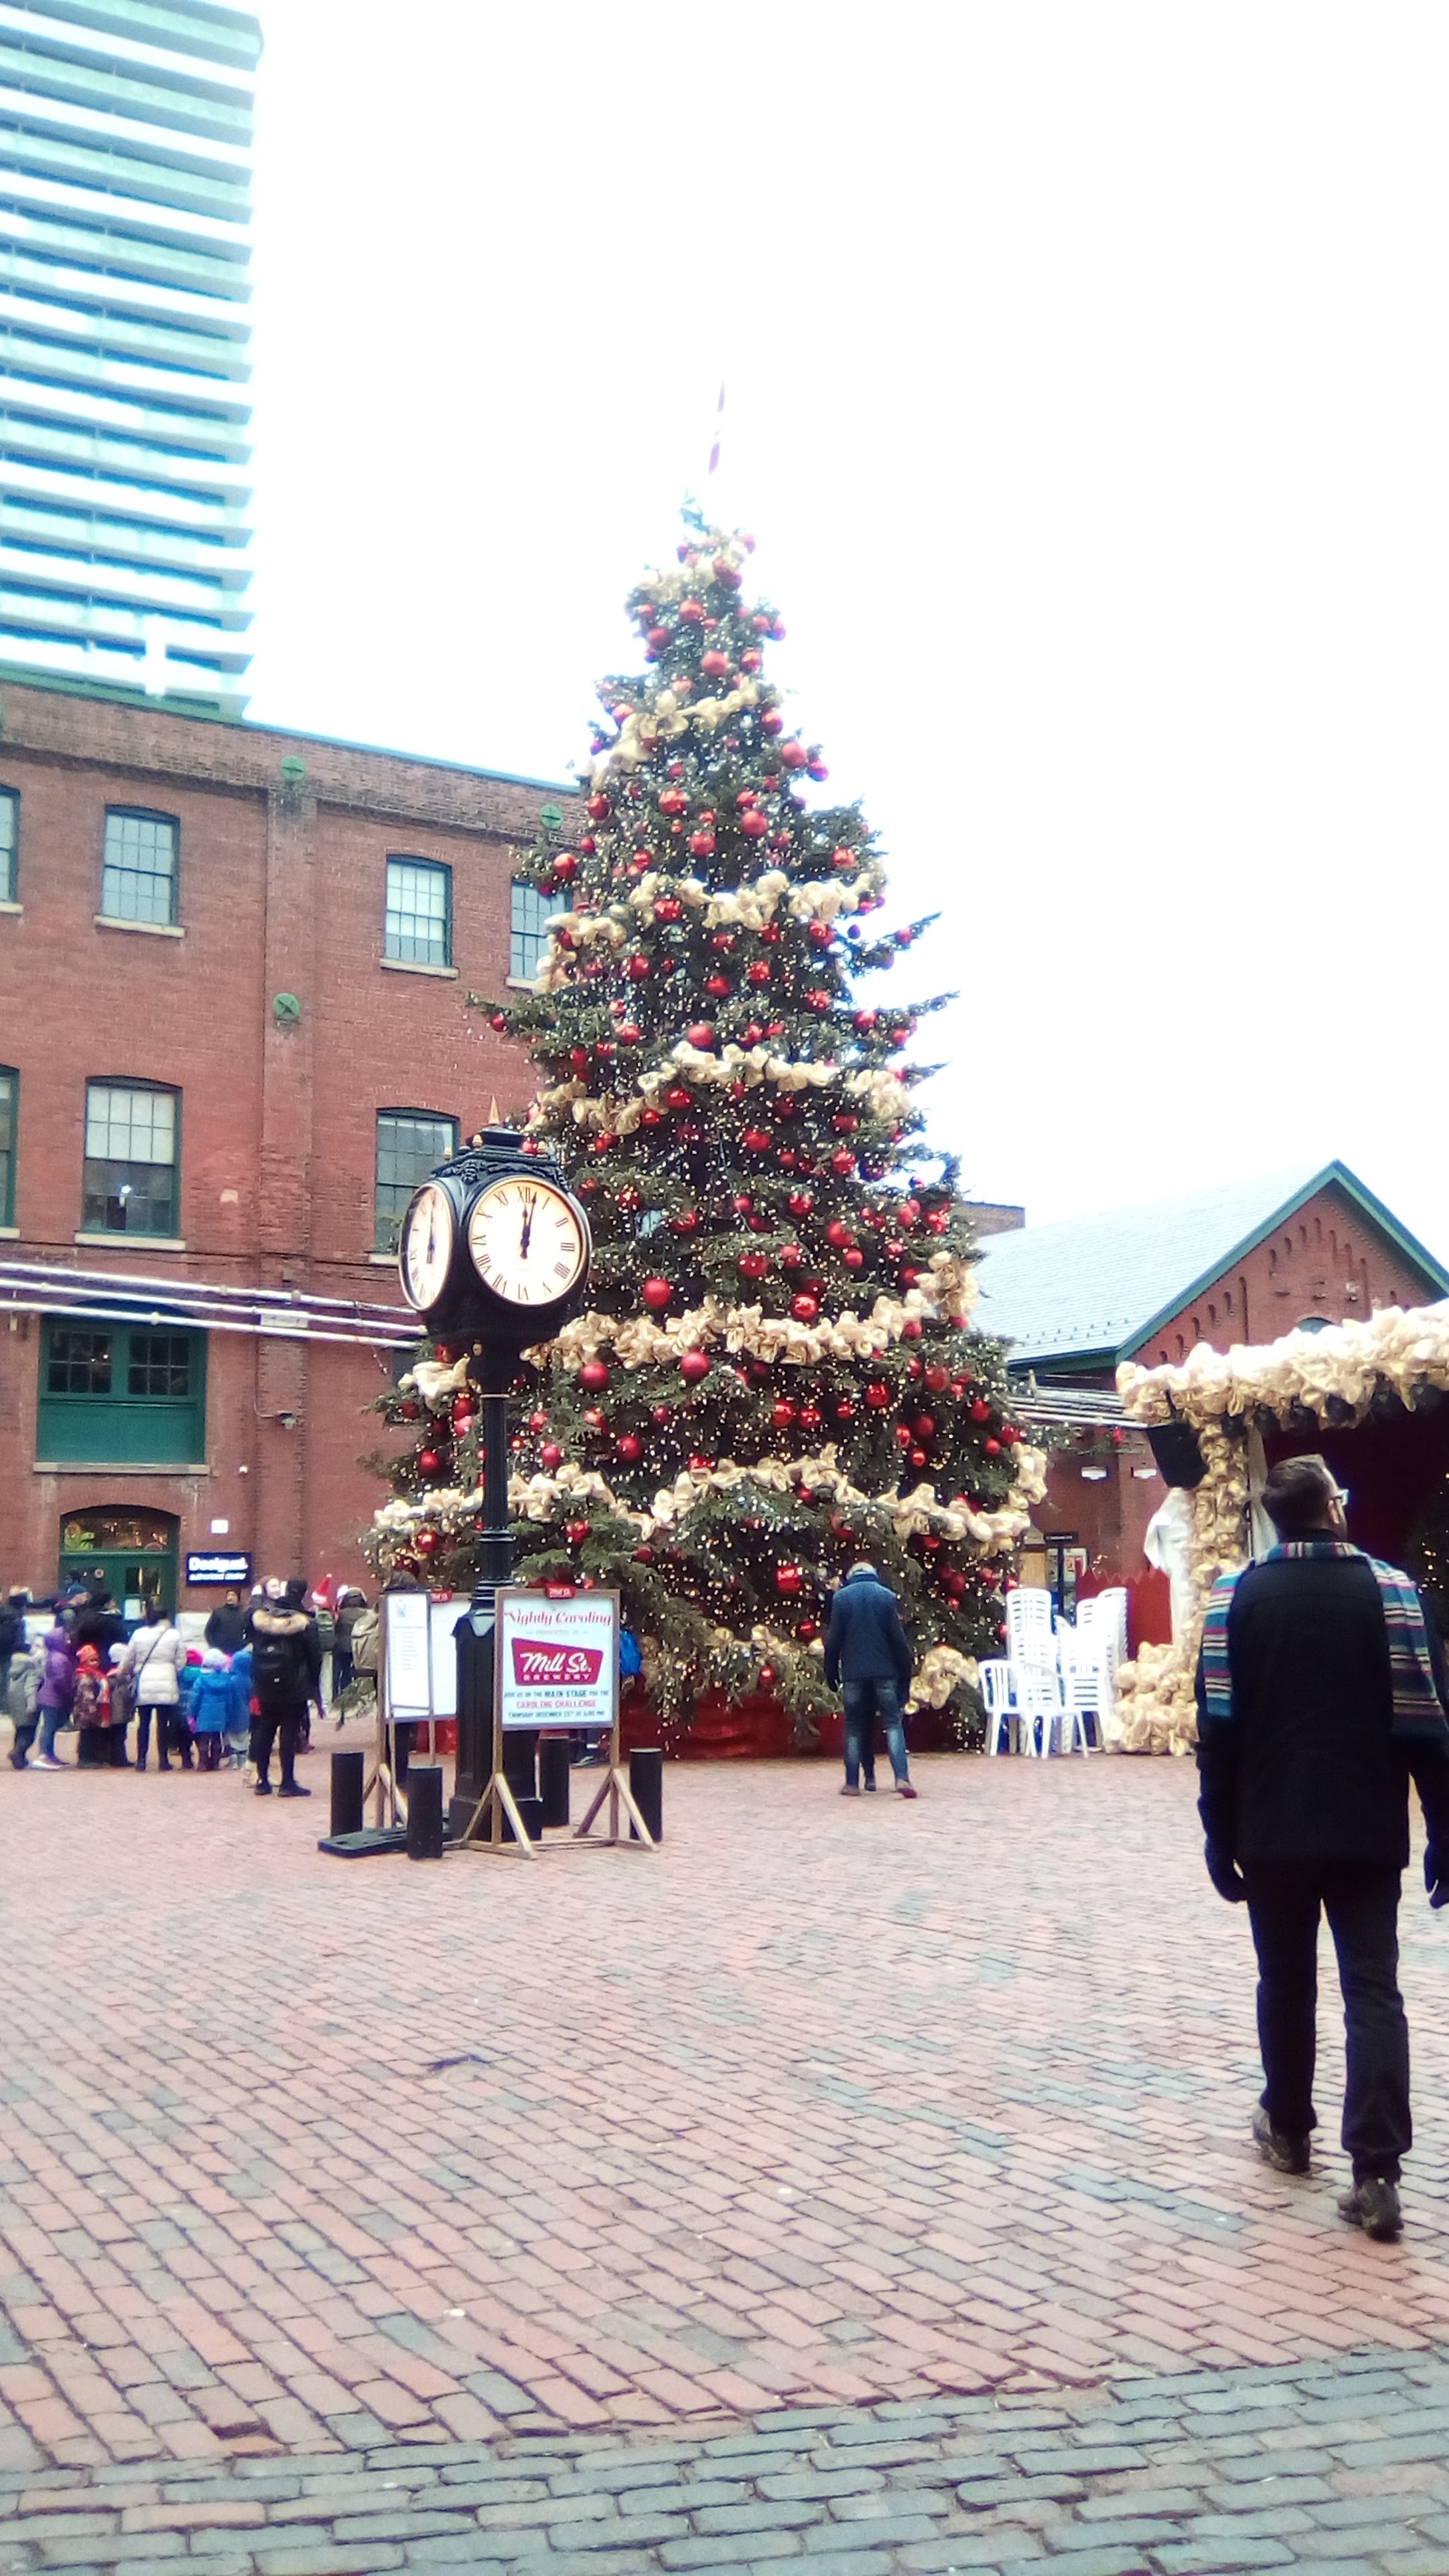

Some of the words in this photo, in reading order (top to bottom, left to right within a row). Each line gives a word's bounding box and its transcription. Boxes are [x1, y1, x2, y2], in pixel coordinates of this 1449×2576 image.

[517, 1186, 531, 1203] XII
[504, 1608, 552, 1626] Nightly
[555, 1611, 612, 1627] Caroling
[520, 1652, 566, 1672] Mill
[566, 1652, 592, 1673] St.
[517, 1701, 553, 1709] CAROLING
[555, 1699, 596, 1708] CHALLENGE
